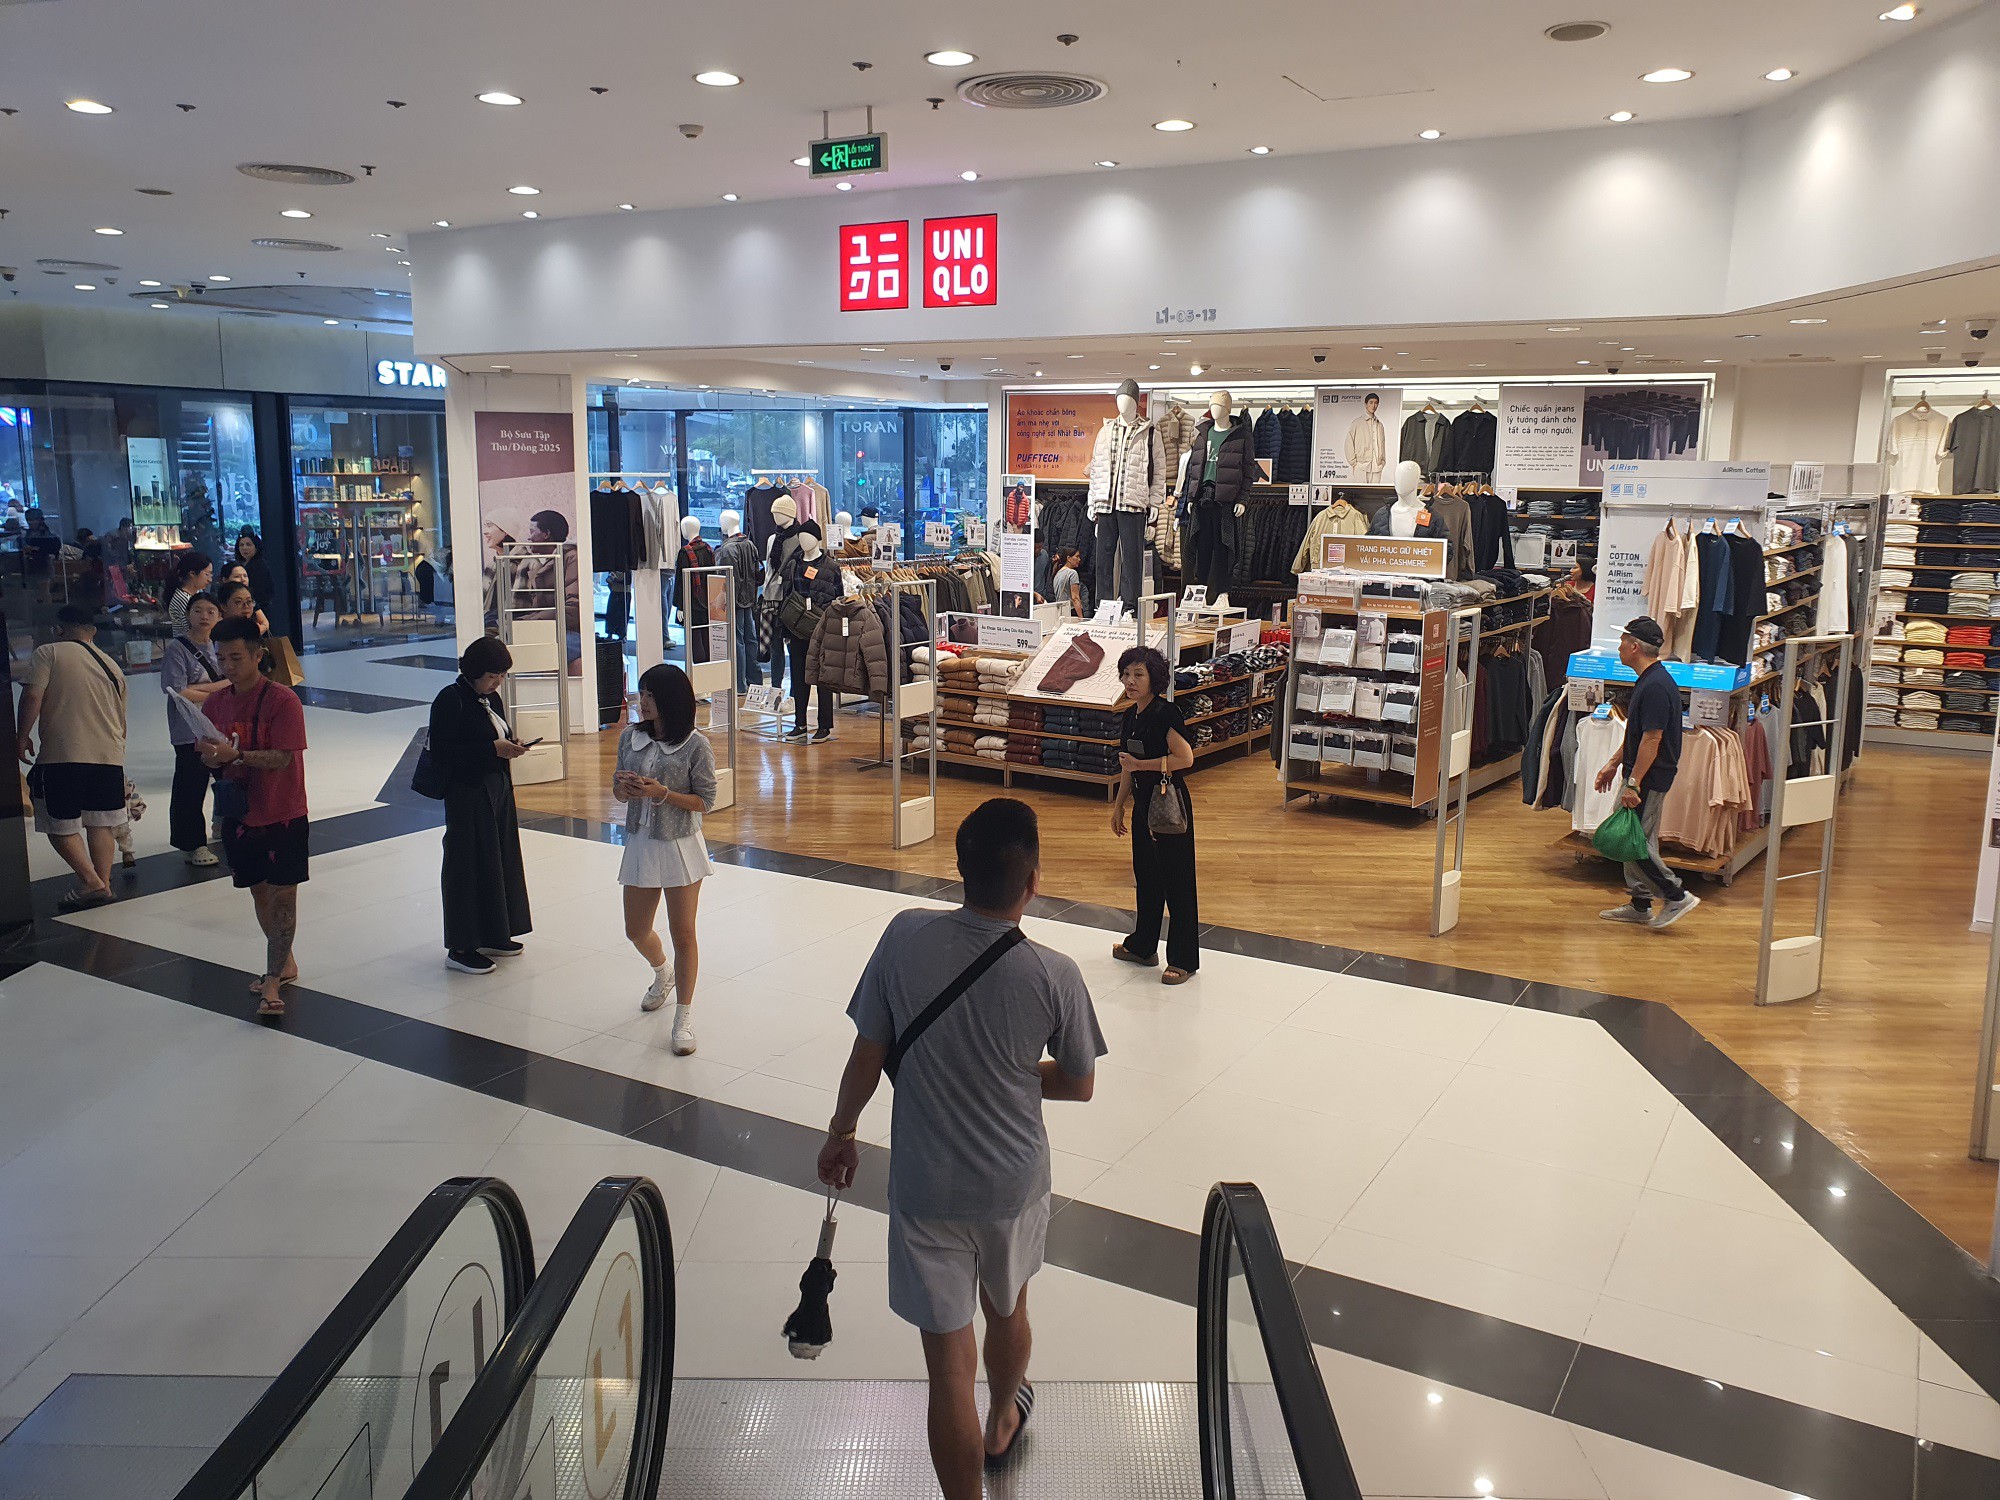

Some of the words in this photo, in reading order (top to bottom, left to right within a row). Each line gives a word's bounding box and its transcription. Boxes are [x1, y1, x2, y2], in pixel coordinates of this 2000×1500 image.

[851, 158, 872, 168] EXIT
[932, 227, 984, 261] UNI
[932, 264, 988, 302] QLO
[1510, 404, 1530, 413] Chiếc
[1534, 404, 1552, 414] quần
[1554, 405, 1575, 414] jeans
[500, 429, 513, 440] Bộ
[514, 430, 532, 439] Sưu
[533, 430, 550, 442] Tập
[1508, 426, 1519, 434] tất
[1534, 427, 1548, 435] mọi
[491, 442, 537, 454] Thu/Đông
[538, 443, 560, 453] 2025
[1017, 454, 1059, 462] PUFFTECH
[1356, 545, 1378, 553] TRANG
[1380, 546, 1398, 555] PHỤC
[1413, 548, 1433, 557] NHIỆT
[1017, 639, 1028, 648] 599
